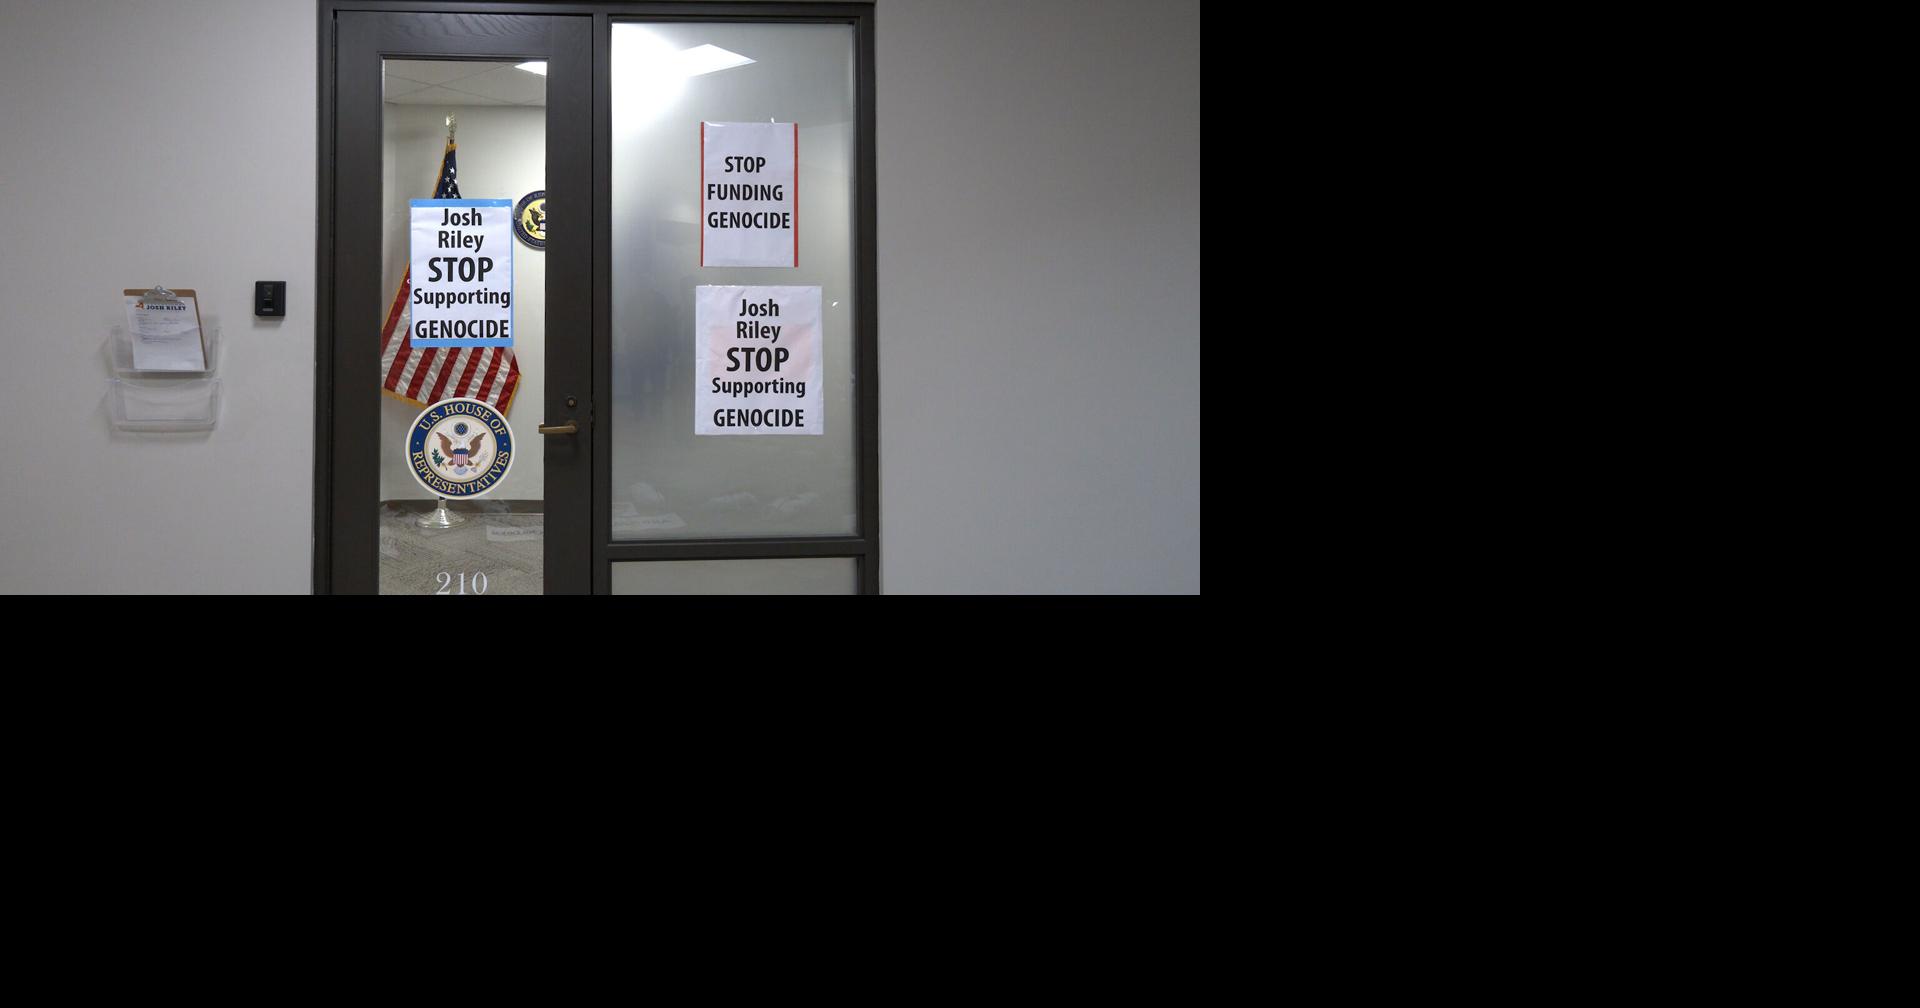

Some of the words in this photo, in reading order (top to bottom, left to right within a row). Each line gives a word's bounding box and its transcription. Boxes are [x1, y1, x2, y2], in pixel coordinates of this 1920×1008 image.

[725, 156, 766, 173] STOP
[707, 184, 783, 201] FUNDING
[441, 208, 482, 226] Josh
[707, 212, 790, 229] GENOCIDE
[438, 231, 484, 253] Riley
[428, 257, 494, 282] STOP
[414, 288, 510, 309] Supporting
[739, 299, 779, 316] Josh
[415, 320, 509, 338] GENOCIDE
[737, 321, 781, 343] Riley
[726, 347, 789, 372] STOP
[712, 377, 806, 398] Supporting
[419, 411, 443, 431] U.S.
[445, 403, 492, 421] HOUSE
[490, 421, 506, 438] OF
[713, 409, 804, 427] GENOCIDE
[413, 450, 509, 493] REPRESENTATIVES
[436, 571, 488, 595] 210
